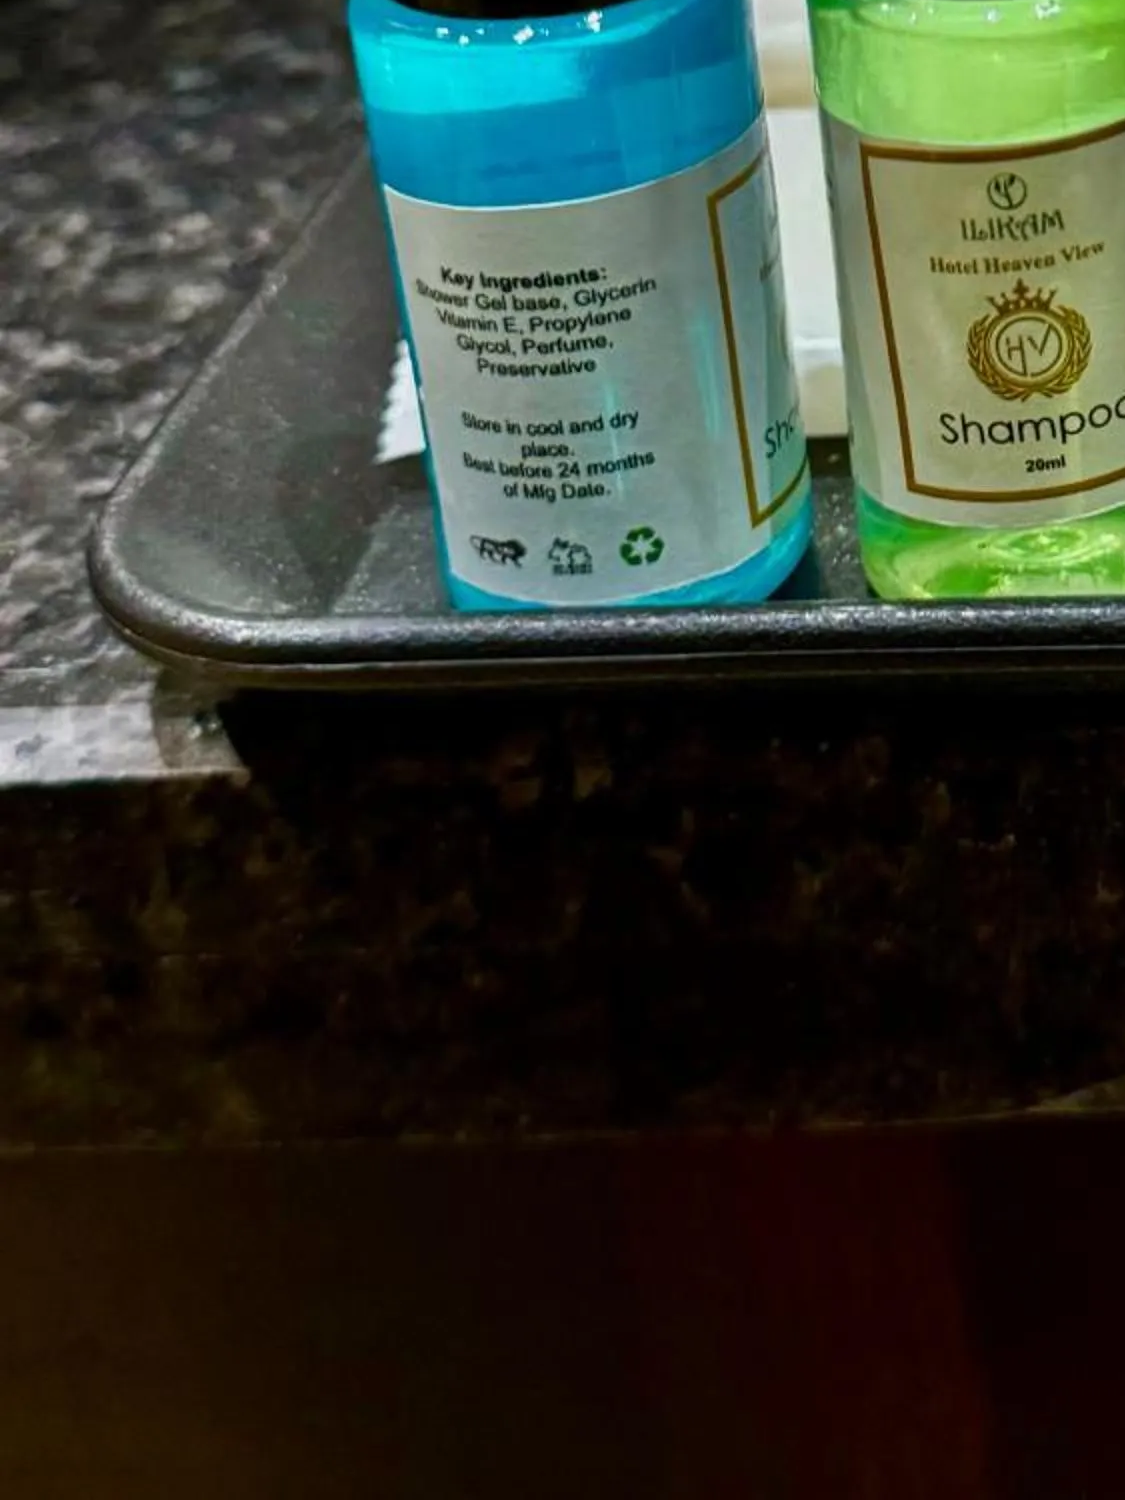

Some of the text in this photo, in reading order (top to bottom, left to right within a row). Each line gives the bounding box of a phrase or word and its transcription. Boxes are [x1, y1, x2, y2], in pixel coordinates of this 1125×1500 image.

[930, 241, 1105, 275] Hotel Heaven View
[441, 265, 607, 292] Key Ingredients:
[475, 293, 507, 311] Gel
[512, 295, 568, 312] base,
[573, 277, 657, 307] Glycerin
[436, 307, 498, 332] Vitamin
[529, 308, 631, 334] Propylene
[456, 333, 614, 357] Glycol, Perfume,
[477, 357, 597, 377] Preservative
[461, 411, 639, 436] Store in cool and dry
[521, 441, 575, 459] place.
[463, 451, 656, 478] Best before 24 months
[1025, 454, 1066, 474] 20ml
[503, 483, 518, 498] of
[523, 482, 557, 503] Mfg
